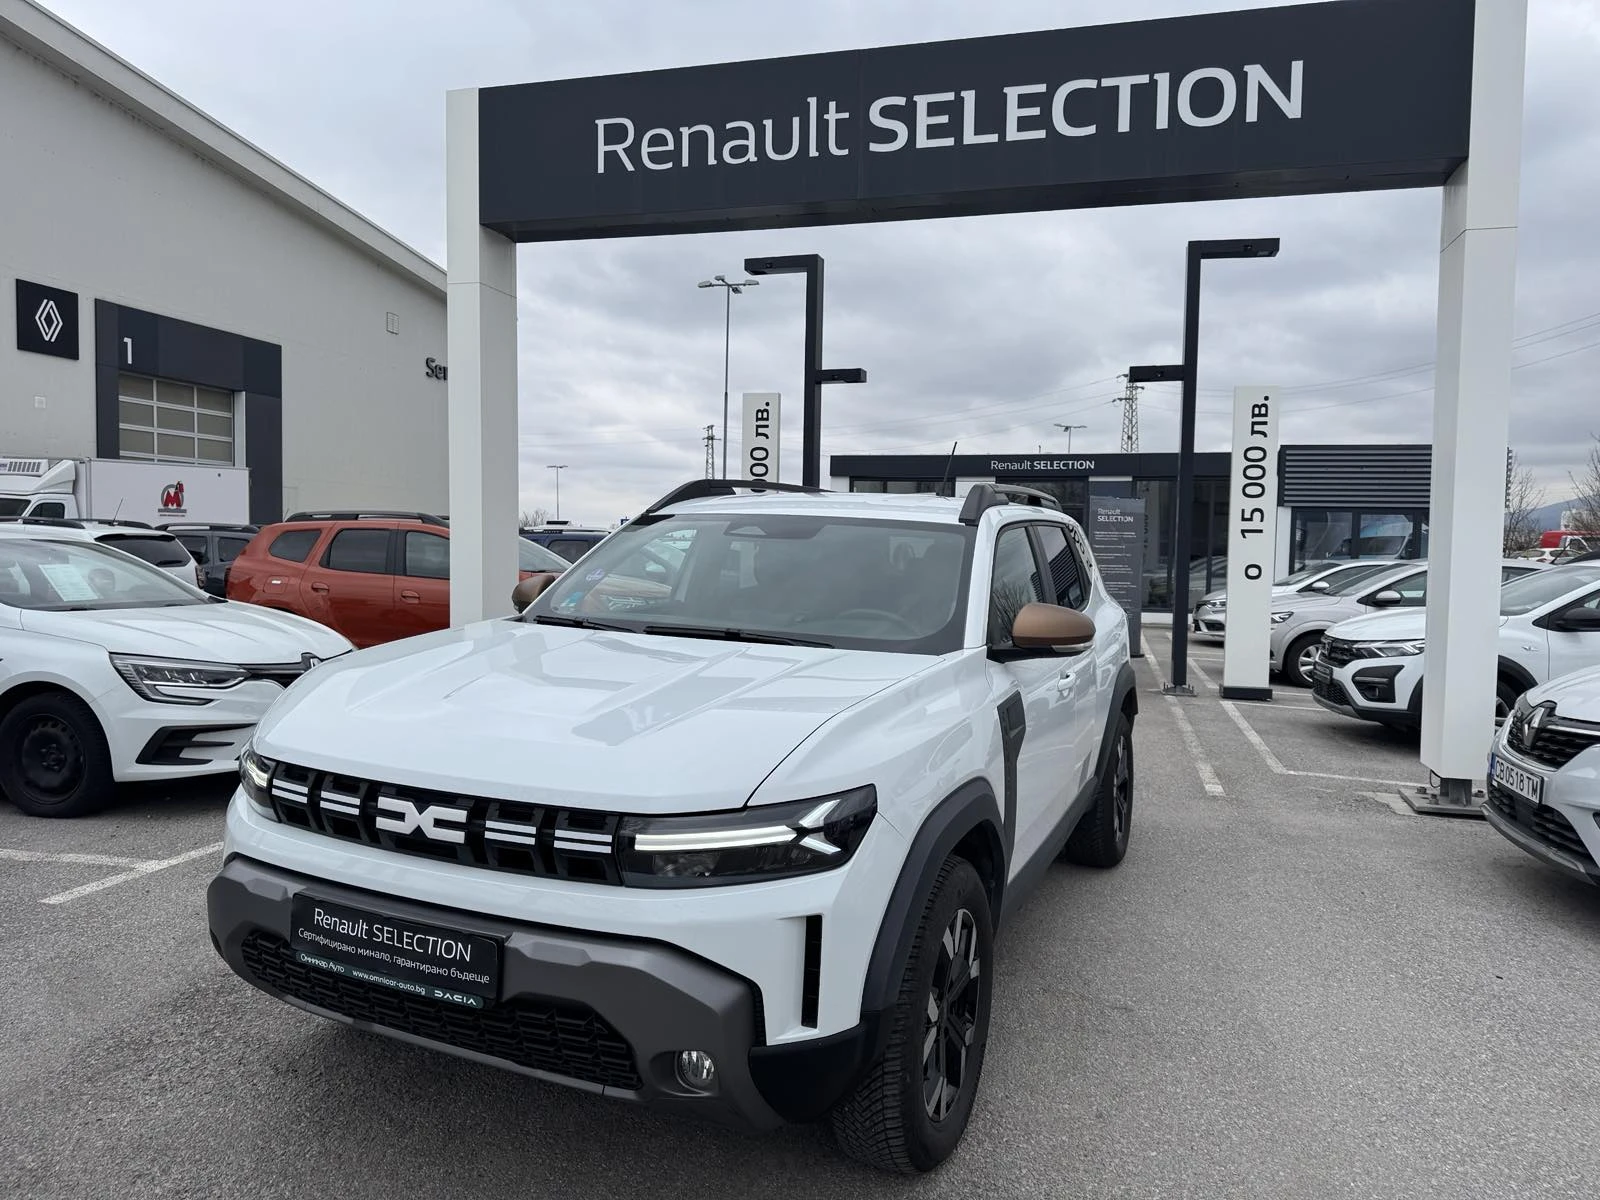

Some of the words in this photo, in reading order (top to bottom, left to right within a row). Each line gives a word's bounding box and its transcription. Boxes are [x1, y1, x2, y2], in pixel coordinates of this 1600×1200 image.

[594, 96, 850, 174] Renault
[868, 60, 1304, 154] SELECTION
[123, 337, 132, 364] 1
[1250, 395, 1270, 438] лв.
[990, 459, 1032, 470] Renault
[1033, 459, 1095, 470] SELECTION
[1241, 446, 1267, 499] 000
[1097, 515, 1134, 523] SELECTION
[1240, 507, 1265, 539] 15
[314, 907, 369, 939] Renault
[372, 924, 471, 963] SELECTION
[298, 927, 356, 954] Сертифицирано
[357, 947, 392, 964] минало,
[393, 955, 449, 976] гарантирано
[450, 967, 490, 984] бъдеще
[434, 989, 477, 1006] DACIA
